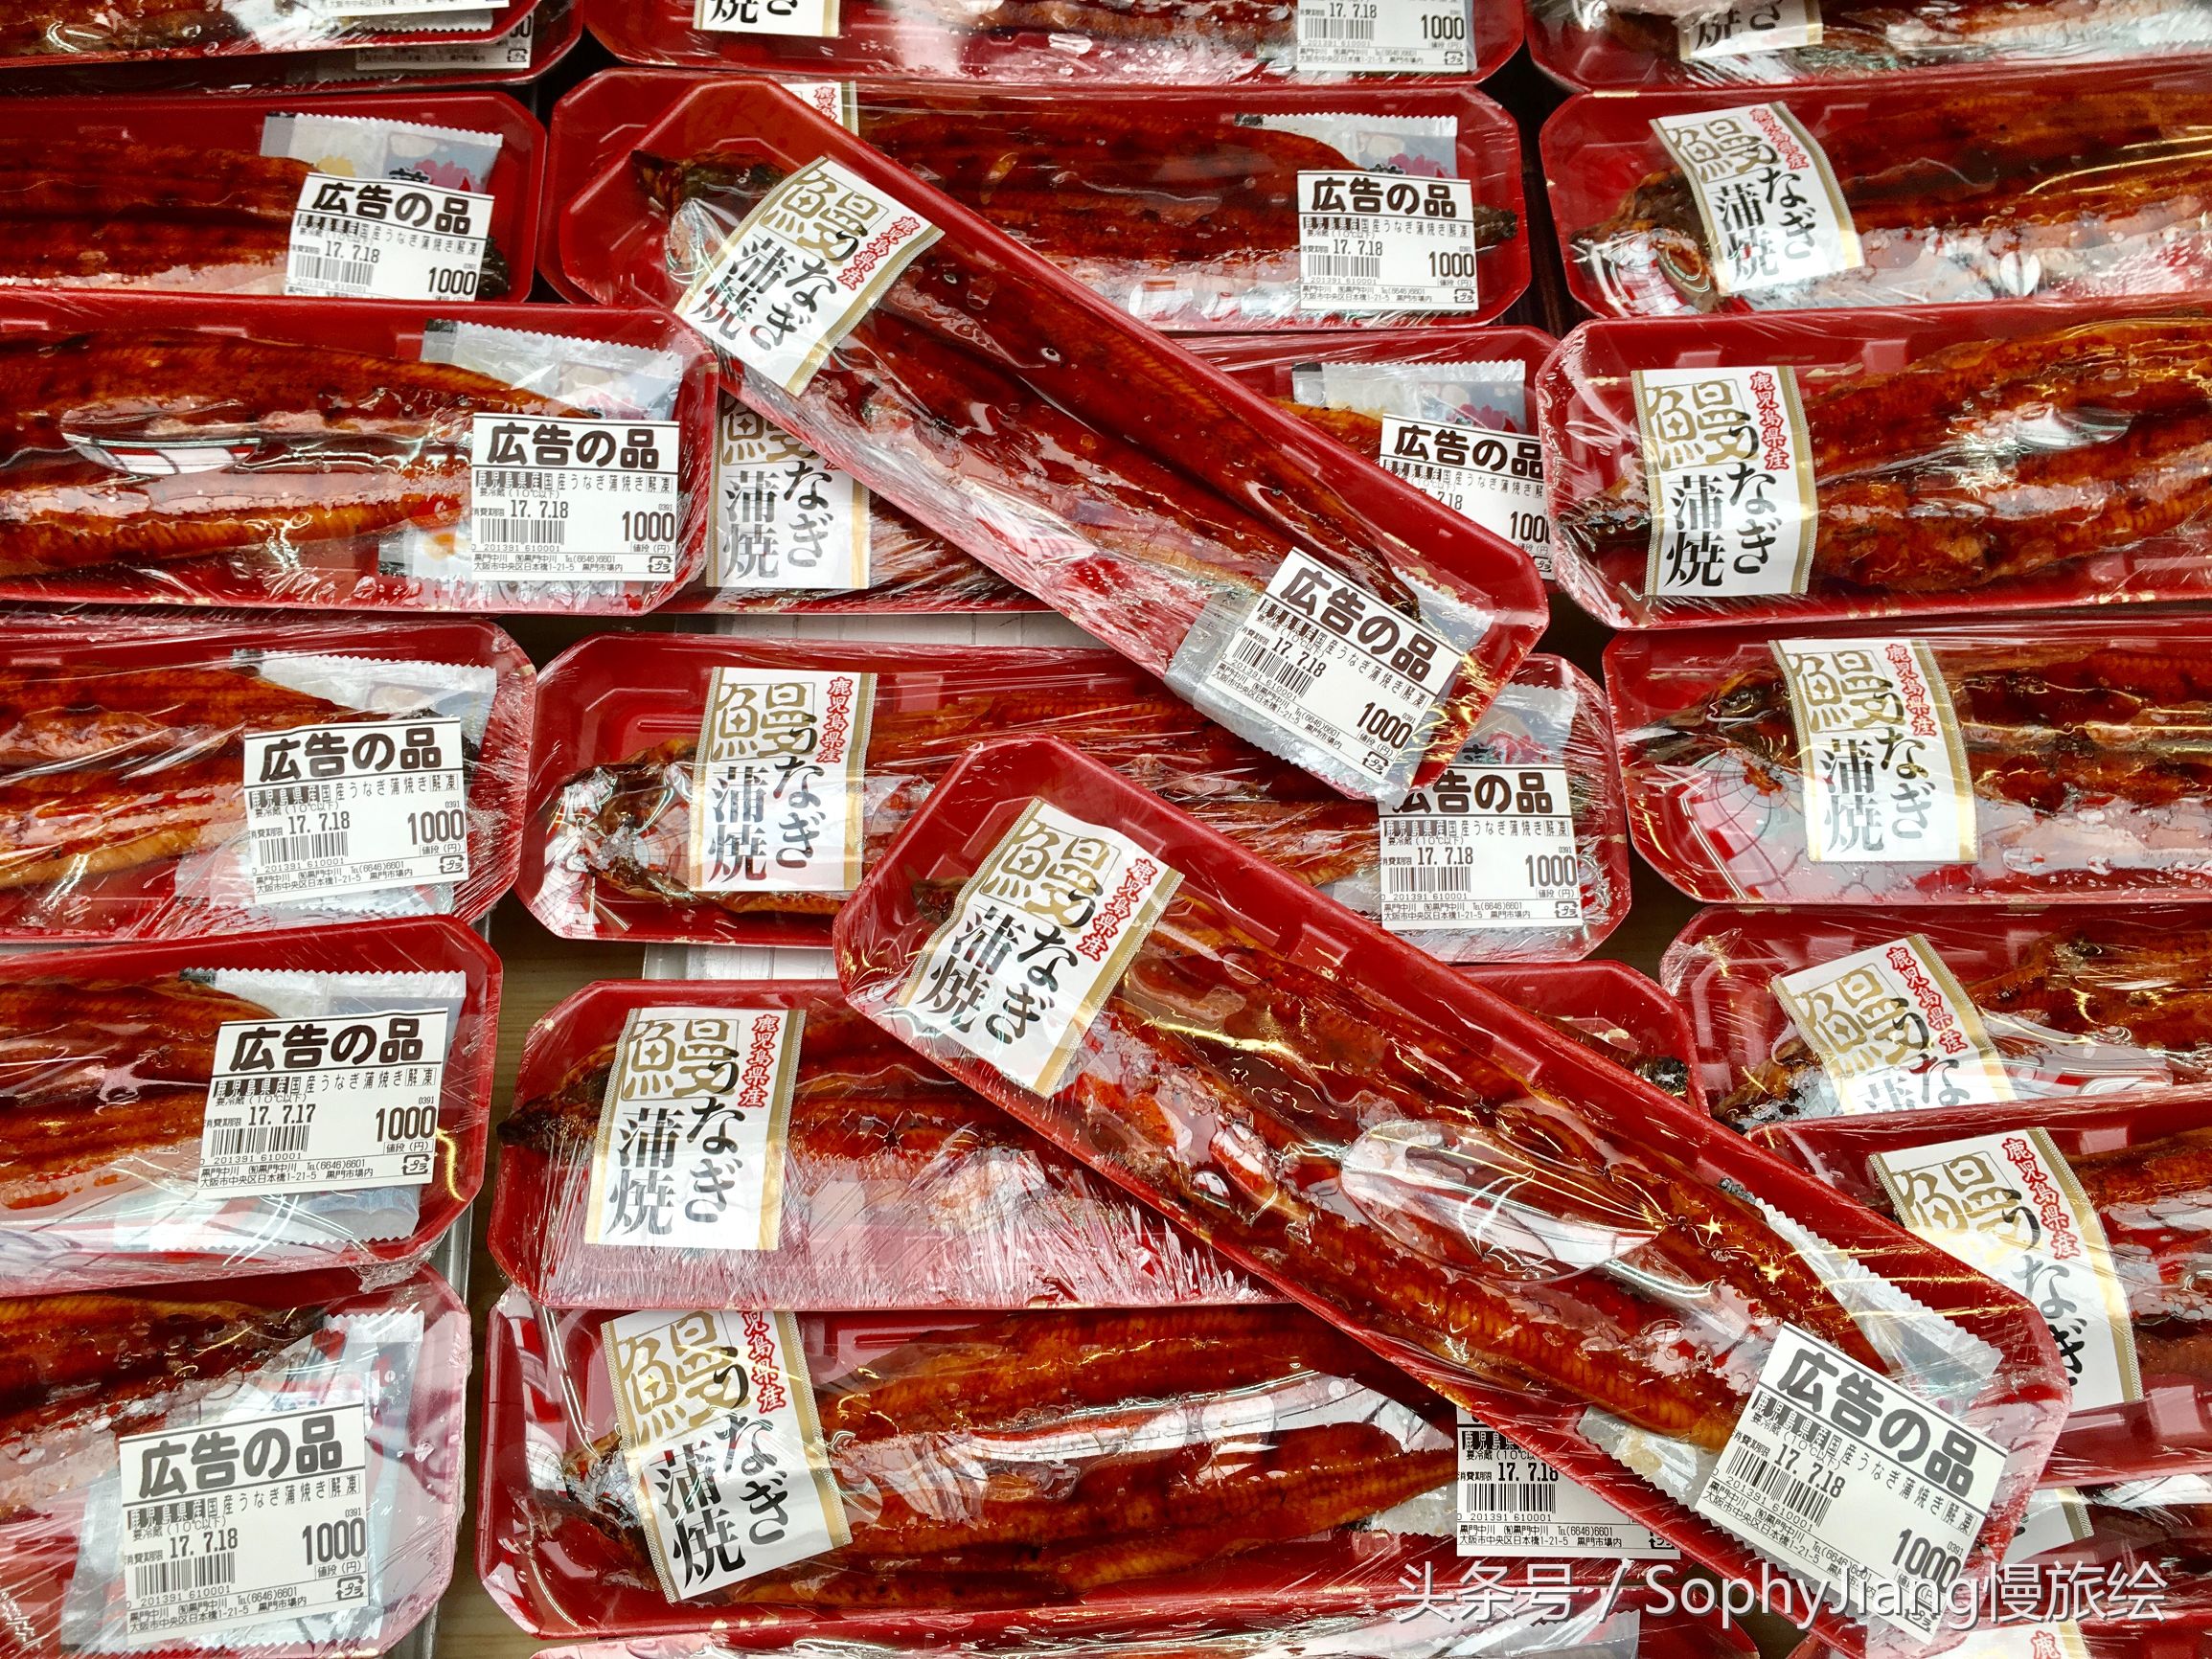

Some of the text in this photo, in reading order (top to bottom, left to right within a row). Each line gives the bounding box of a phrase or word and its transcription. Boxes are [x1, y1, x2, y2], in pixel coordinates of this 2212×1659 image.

[1421, 14, 1465, 39] 1000
[312, 182, 470, 235] 広告の品
[1311, 177, 1456, 217] 広告の品
[837, 216, 921, 290] 鹿児島県産
[1709, 183, 1779, 282] 蒲焼
[429, 267, 476, 295] 1000
[690, 238, 795, 340] 蒲焼
[1428, 251, 1474, 277] 1000
[487, 422, 659, 469] 広告の品
[1750, 371, 1790, 470] 鹿児島県産
[1394, 425, 1543, 479] 広告の品
[622, 511, 674, 541] 1000
[723, 470, 780, 579] 蒲焼
[1664, 475, 1725, 587] 蒲焼
[1280, 567, 1437, 683] 広告の品
[815, 676, 853, 762] 鹿児島県産
[1886, 644, 1937, 737] 鹿児島県産
[259, 727, 442, 782] 広告の品
[1357, 702, 1413, 750] 1000
[708, 766, 768, 883] 蒲焼
[1818, 739, 1884, 852] 蒲焼
[407, 809, 465, 845] 1000
[1525, 855, 1578, 887] 1000
[1076, 858, 1157, 962] 鹿児島県産
[916, 905, 1026, 1034] 蒲焼
[1886, 946, 1968, 1054] 鹿児島県産
[229, 1018, 423, 1072] 広告の品
[739, 1014, 780, 1107] 鹿児島県産
[376, 1105, 437, 1142] 1000
[201, 1168, 239, 1177] 黒門中川
[214, 1152, 301, 1165] 201391 610001
[605, 1107, 685, 1235] 蒲焼
[2002, 1137, 2081, 1260] 鹿児島県産
[1777, 1348, 1977, 1497] 広告の品
[139, 1415, 342, 1498] 広告の品
[649, 1441, 745, 1588] 蒲焼
[1460, 1525, 1494, 1534] 黒門中川
[1725, 1475, 1813, 1533] 201391 610001
[302, 1517, 365, 1565] 1000
[1891, 1528, 1962, 1593] 1000
[130, 1608, 169, 1623] 黒門中川
[141, 1585, 230, 1607] 201391 610001
